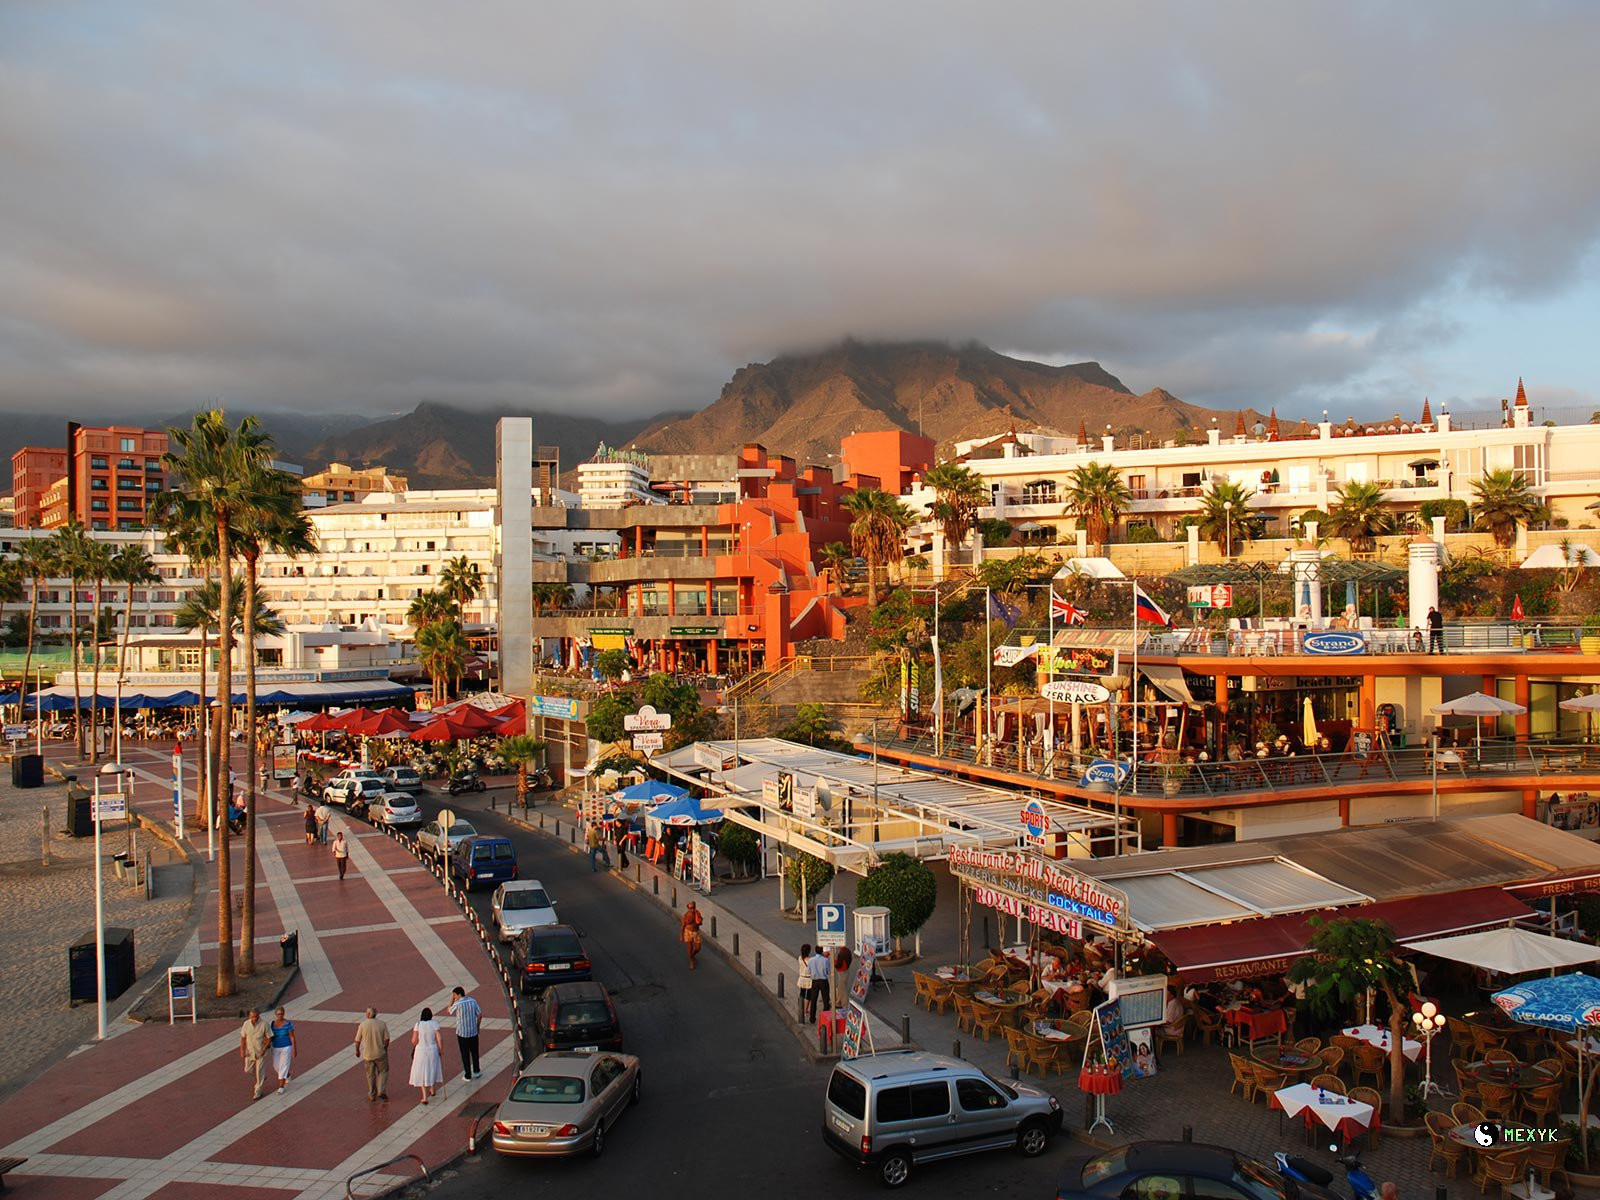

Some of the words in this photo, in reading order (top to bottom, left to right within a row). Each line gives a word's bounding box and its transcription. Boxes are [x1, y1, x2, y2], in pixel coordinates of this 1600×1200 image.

[1310, 639, 1357, 647] Strand
[1091, 656, 1109, 669] bar
[911, 657, 919, 714] SUBWAY
[633, 715, 661, 726] Vera
[1020, 810, 1050, 830] SPORTS
[948, 844, 1011, 871] Restaurante
[1014, 855, 1041, 881] Grill
[1043, 865, 1079, 899] Steak
[1080, 881, 1121, 917] House
[1543, 882, 1576, 894] FRESH
[956, 864, 998, 885] PIZZERIA
[1002, 880, 1043, 901] SNACKS
[1048, 893, 1115, 925] COCKTAILS
[822, 906, 840, 930] P
[976, 886, 1021, 917] ROYAL
[1028, 903, 1082, 940] BEACH
[1215, 959, 1289, 977] RESTAURANTE
[1516, 1012, 1573, 1022] HELADOS
